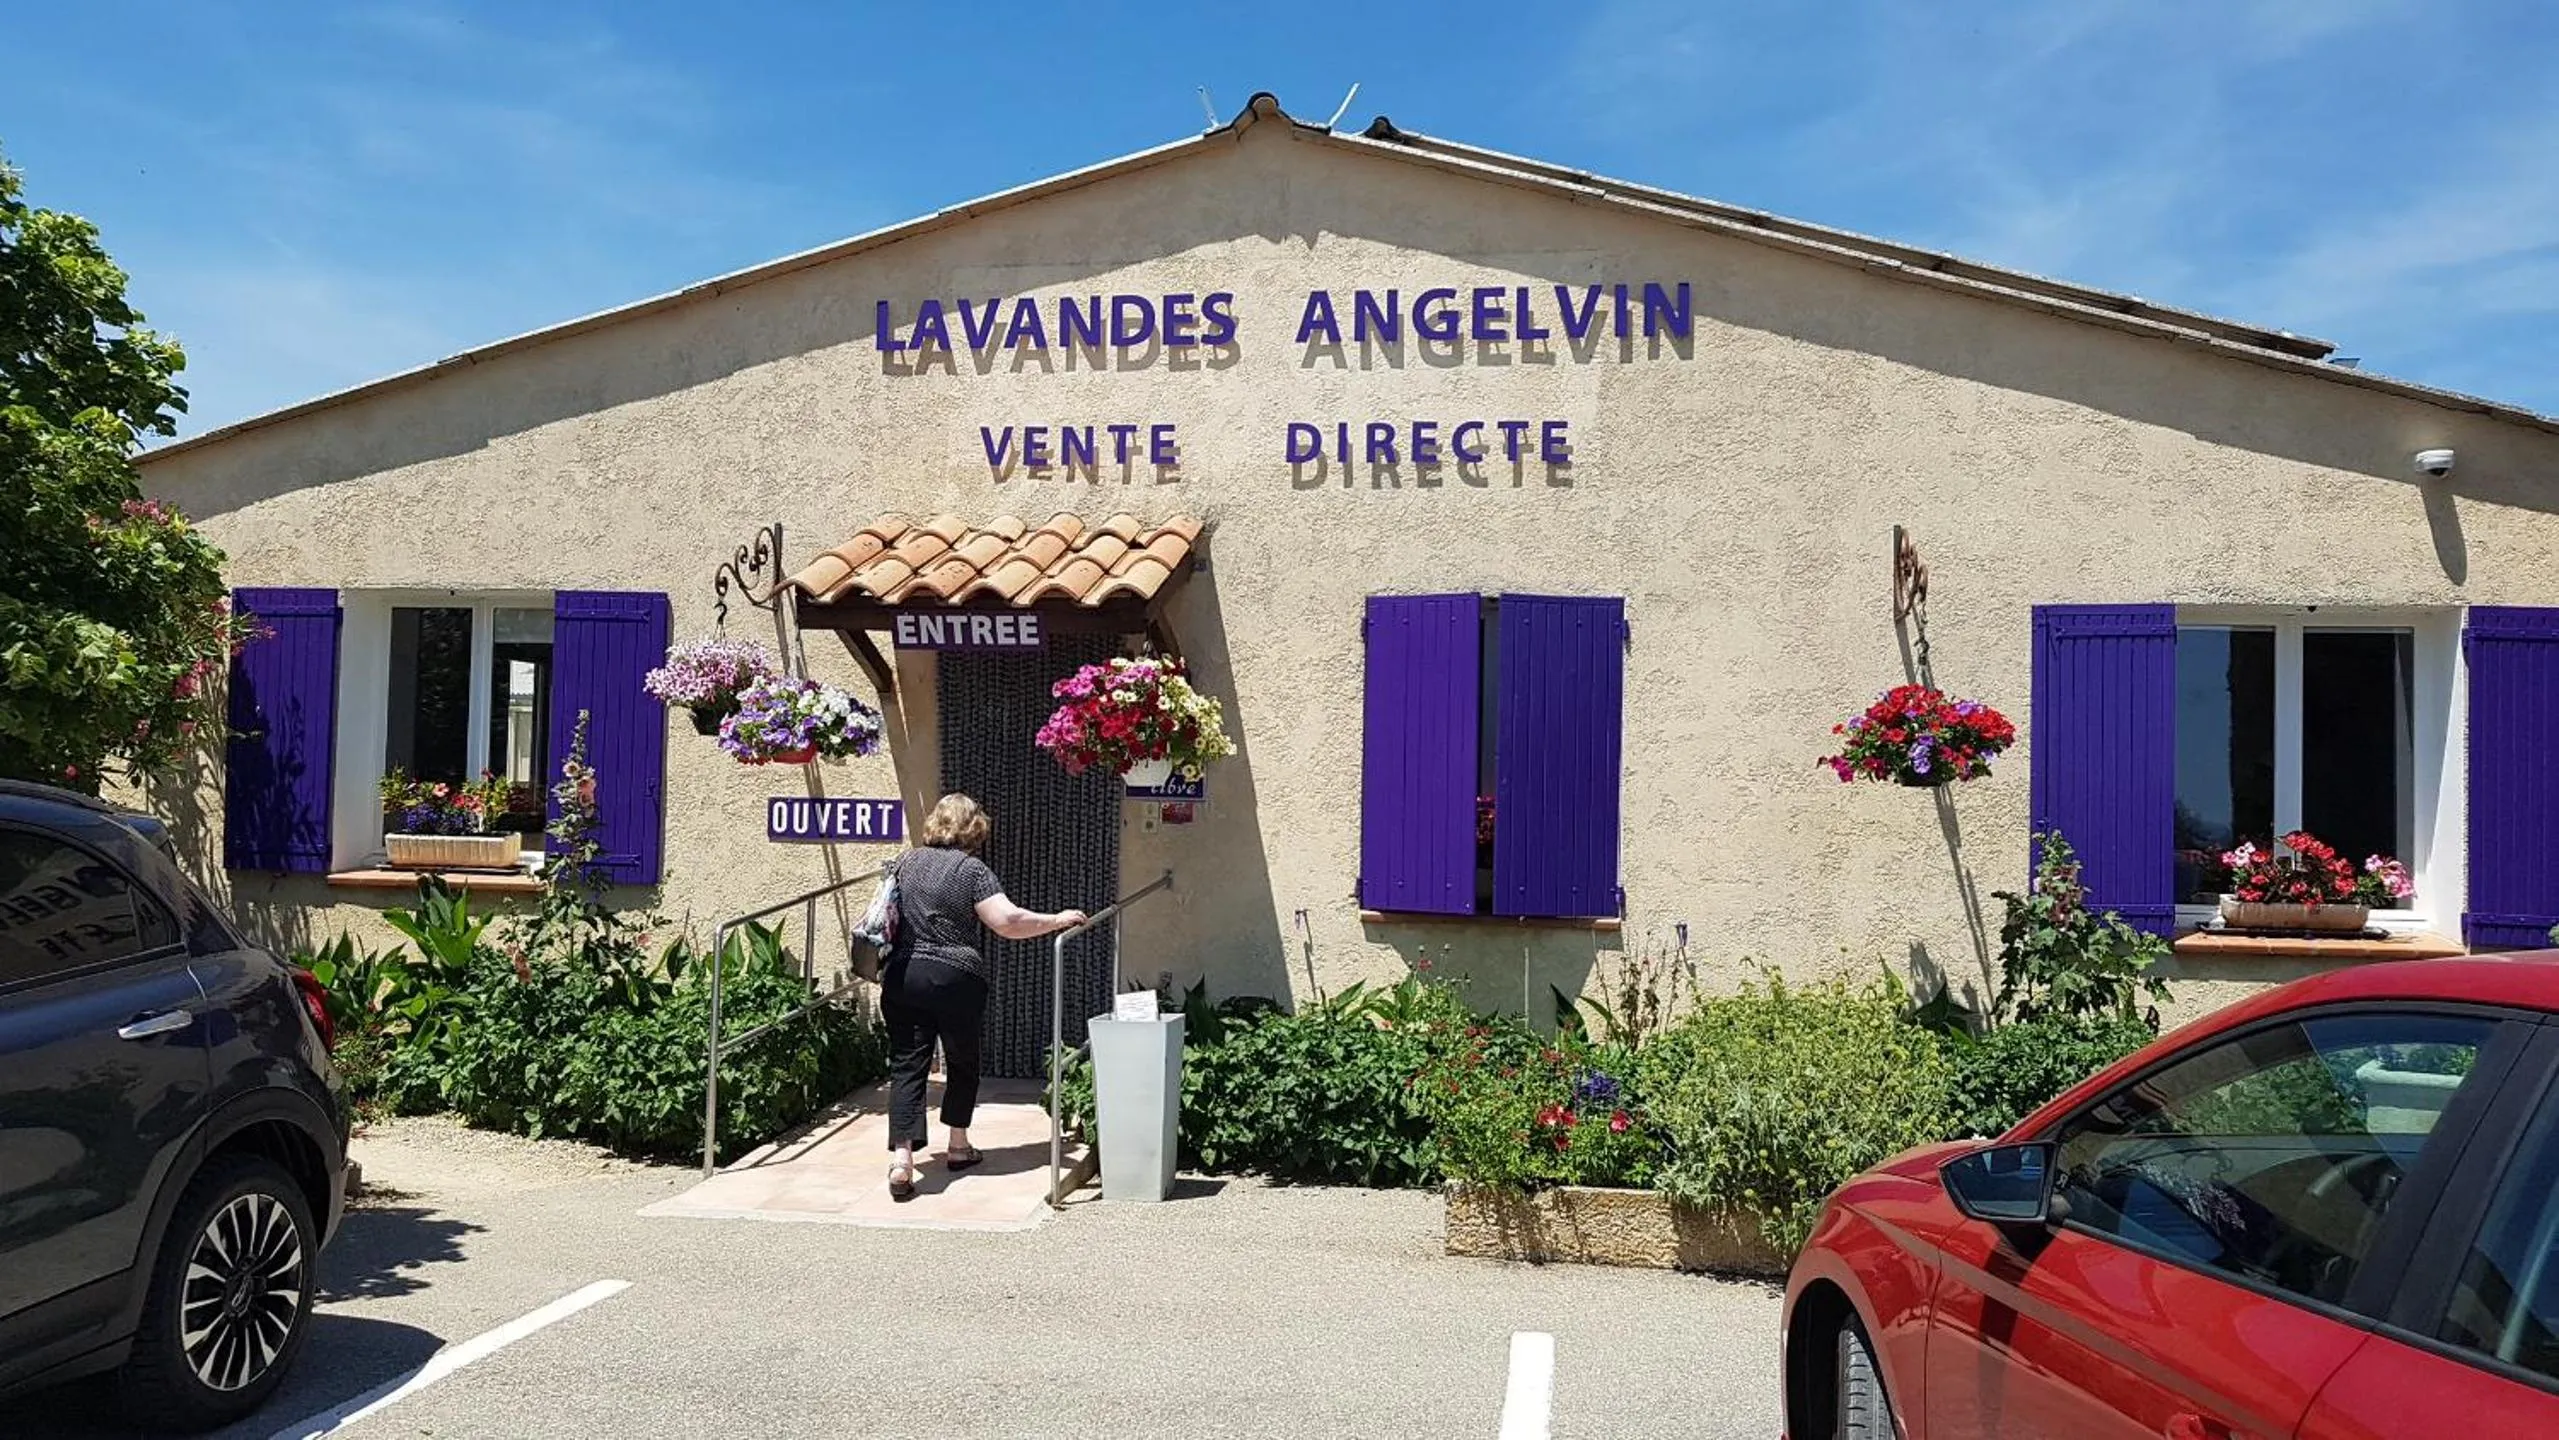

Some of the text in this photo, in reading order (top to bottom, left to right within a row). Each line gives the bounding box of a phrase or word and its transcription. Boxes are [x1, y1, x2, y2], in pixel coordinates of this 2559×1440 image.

[876, 282, 1691, 350] LAVANDES ANGELVIN
[980, 421, 1569, 466] VENTE DIRECTE
[896, 614, 1040, 645] ENTREE
[772, 801, 894, 835] OUVERT
